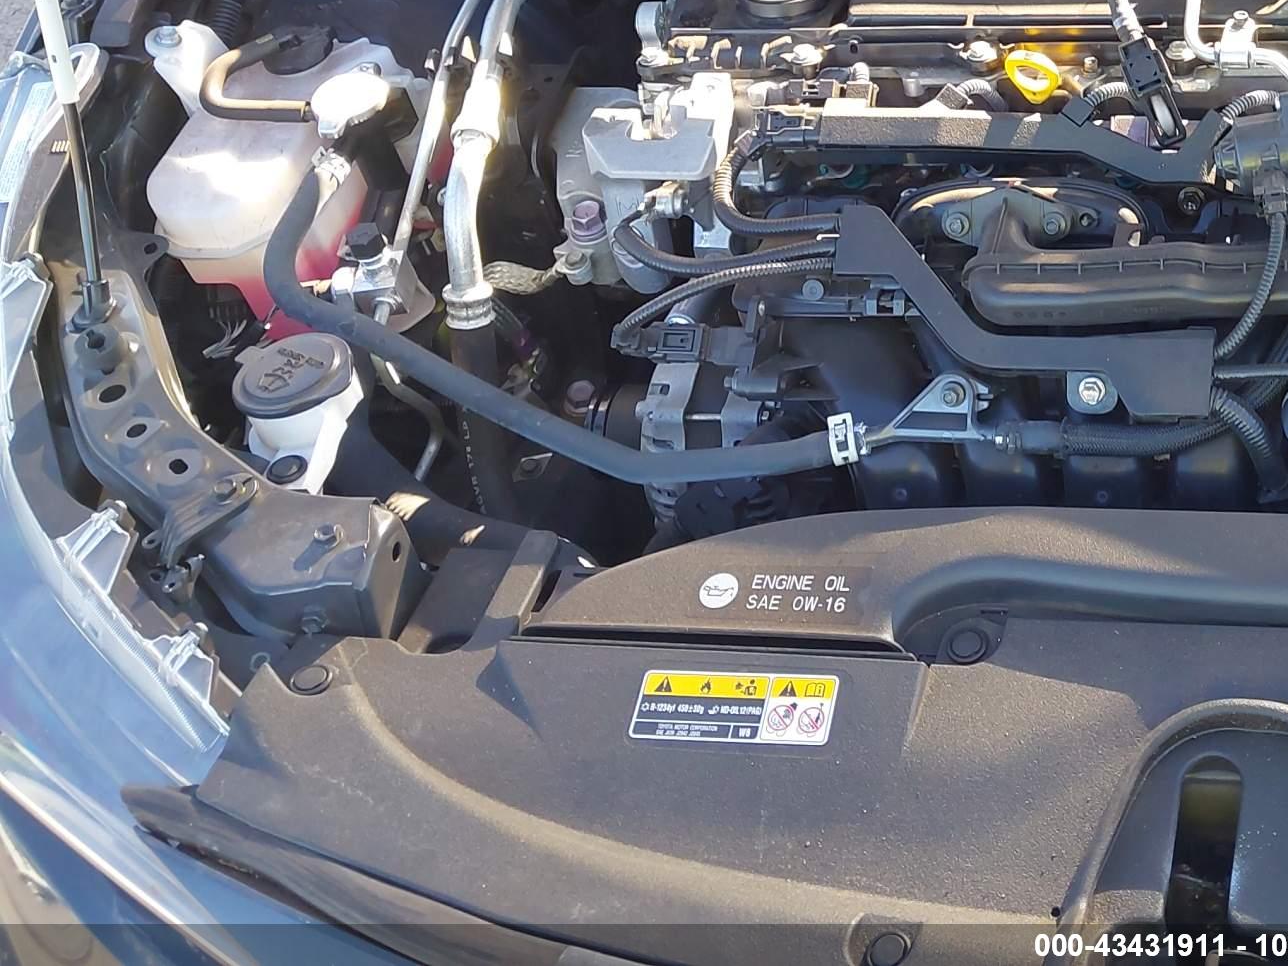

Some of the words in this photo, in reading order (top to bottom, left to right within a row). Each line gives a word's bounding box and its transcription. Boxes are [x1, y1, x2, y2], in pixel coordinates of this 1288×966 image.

[752, 574, 814, 591] ENGINE
[824, 575, 850, 592] OIL
[746, 594, 782, 610] SAE
[792, 596, 846, 613] 0W-16
